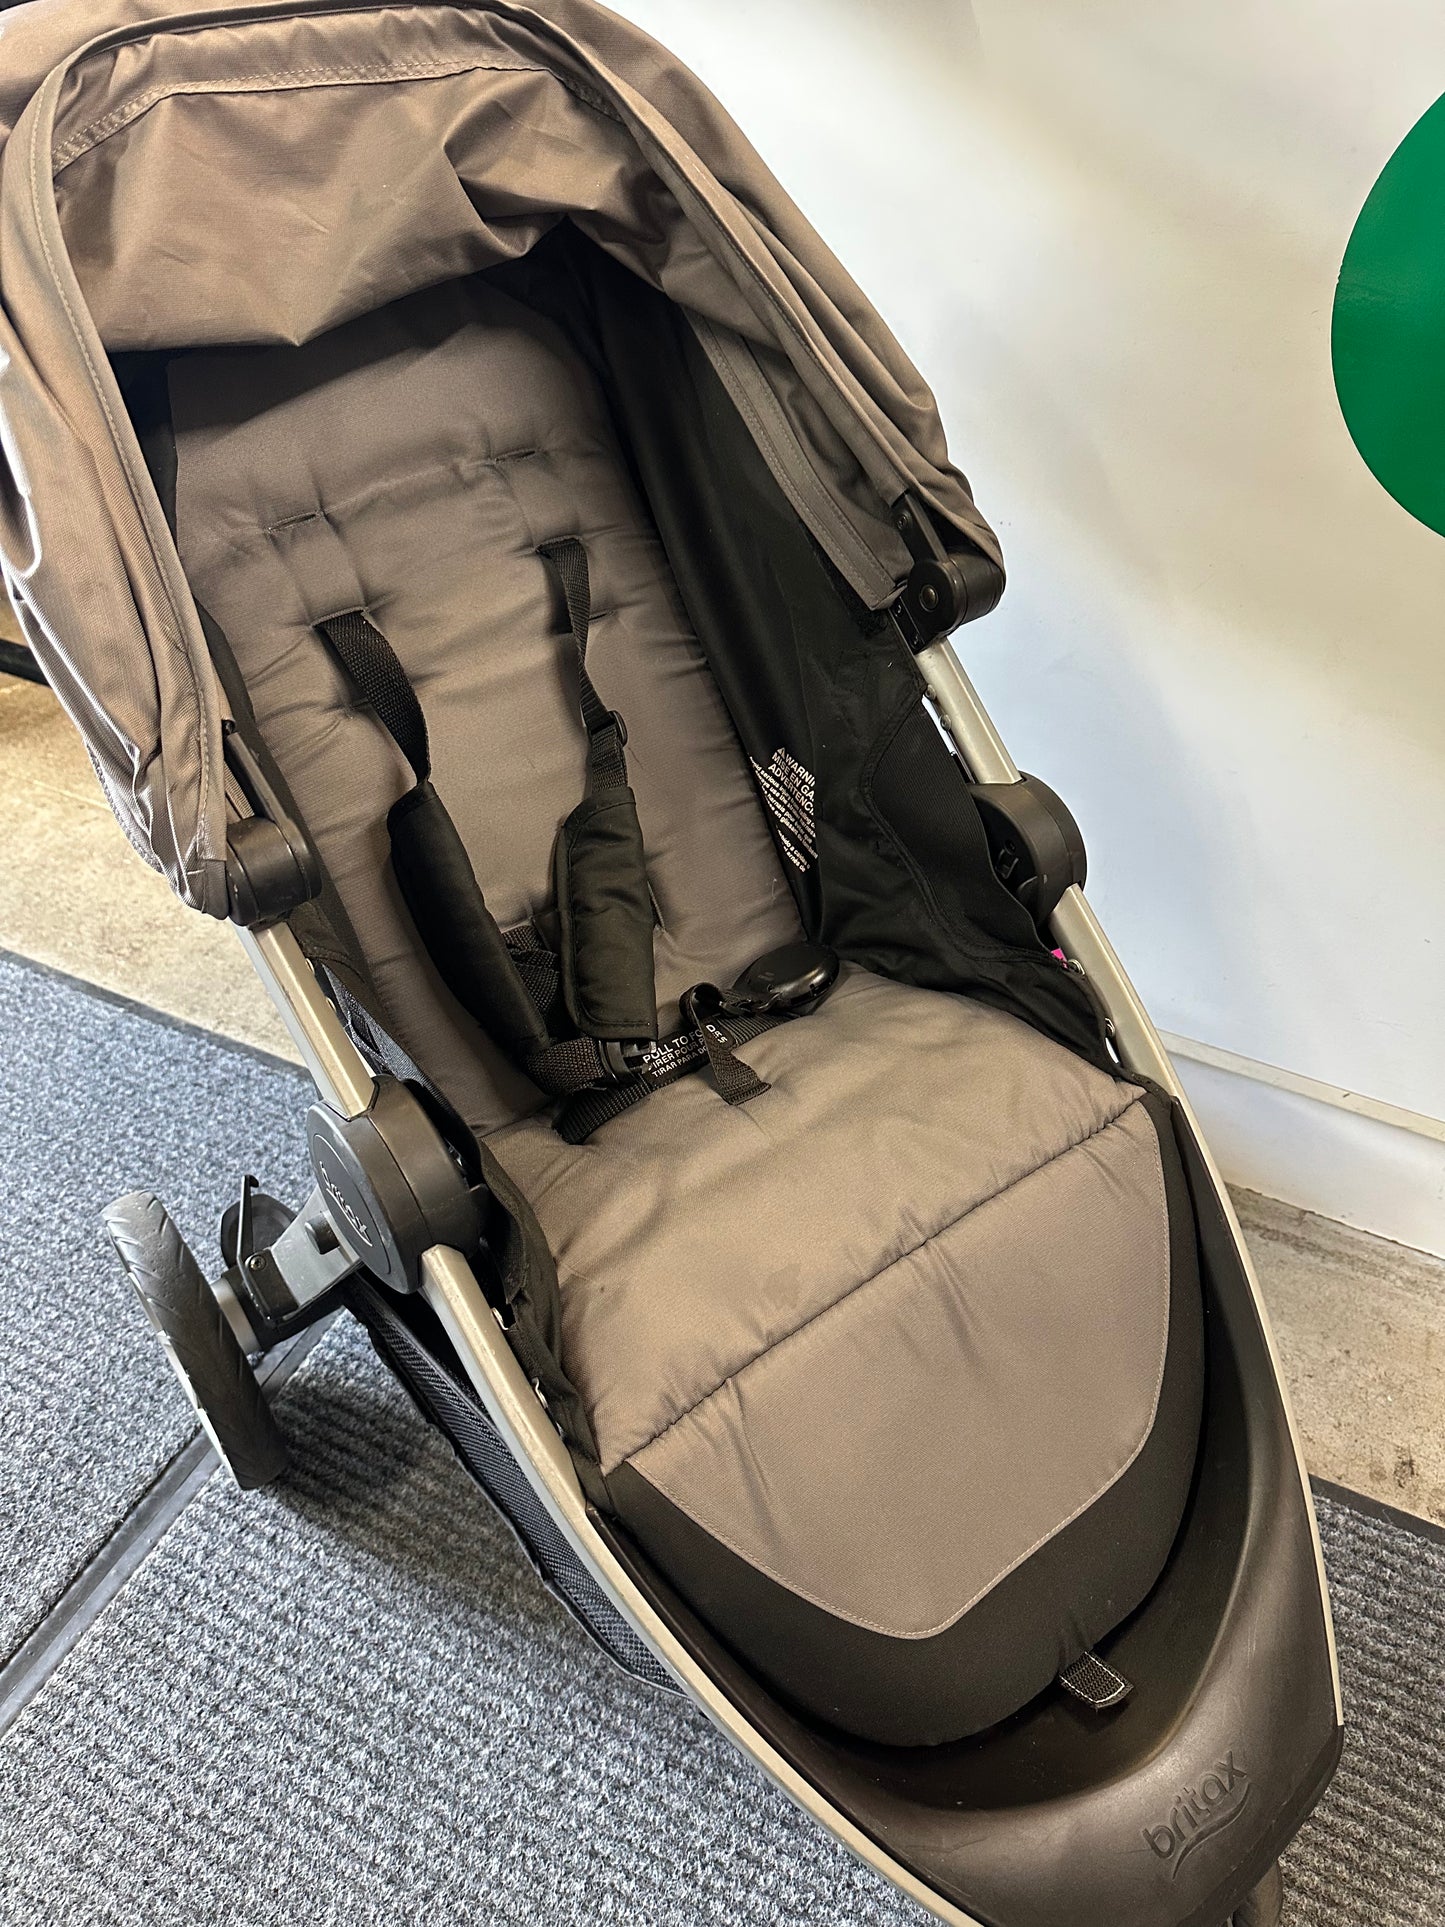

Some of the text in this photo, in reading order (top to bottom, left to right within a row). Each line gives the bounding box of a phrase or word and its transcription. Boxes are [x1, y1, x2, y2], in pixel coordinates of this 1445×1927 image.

[772, 752, 815, 802] MISE EN GA
[642, 1044, 674, 1064] PULL
[671, 1035, 689, 1048] TO
[648, 1052, 675, 1069] IRER
[674, 1041, 699, 1058] POUR
[651, 1061, 678, 1078] TIRAR
[676, 1050, 699, 1066] PARA
[1141, 1750, 1248, 1860] britax
